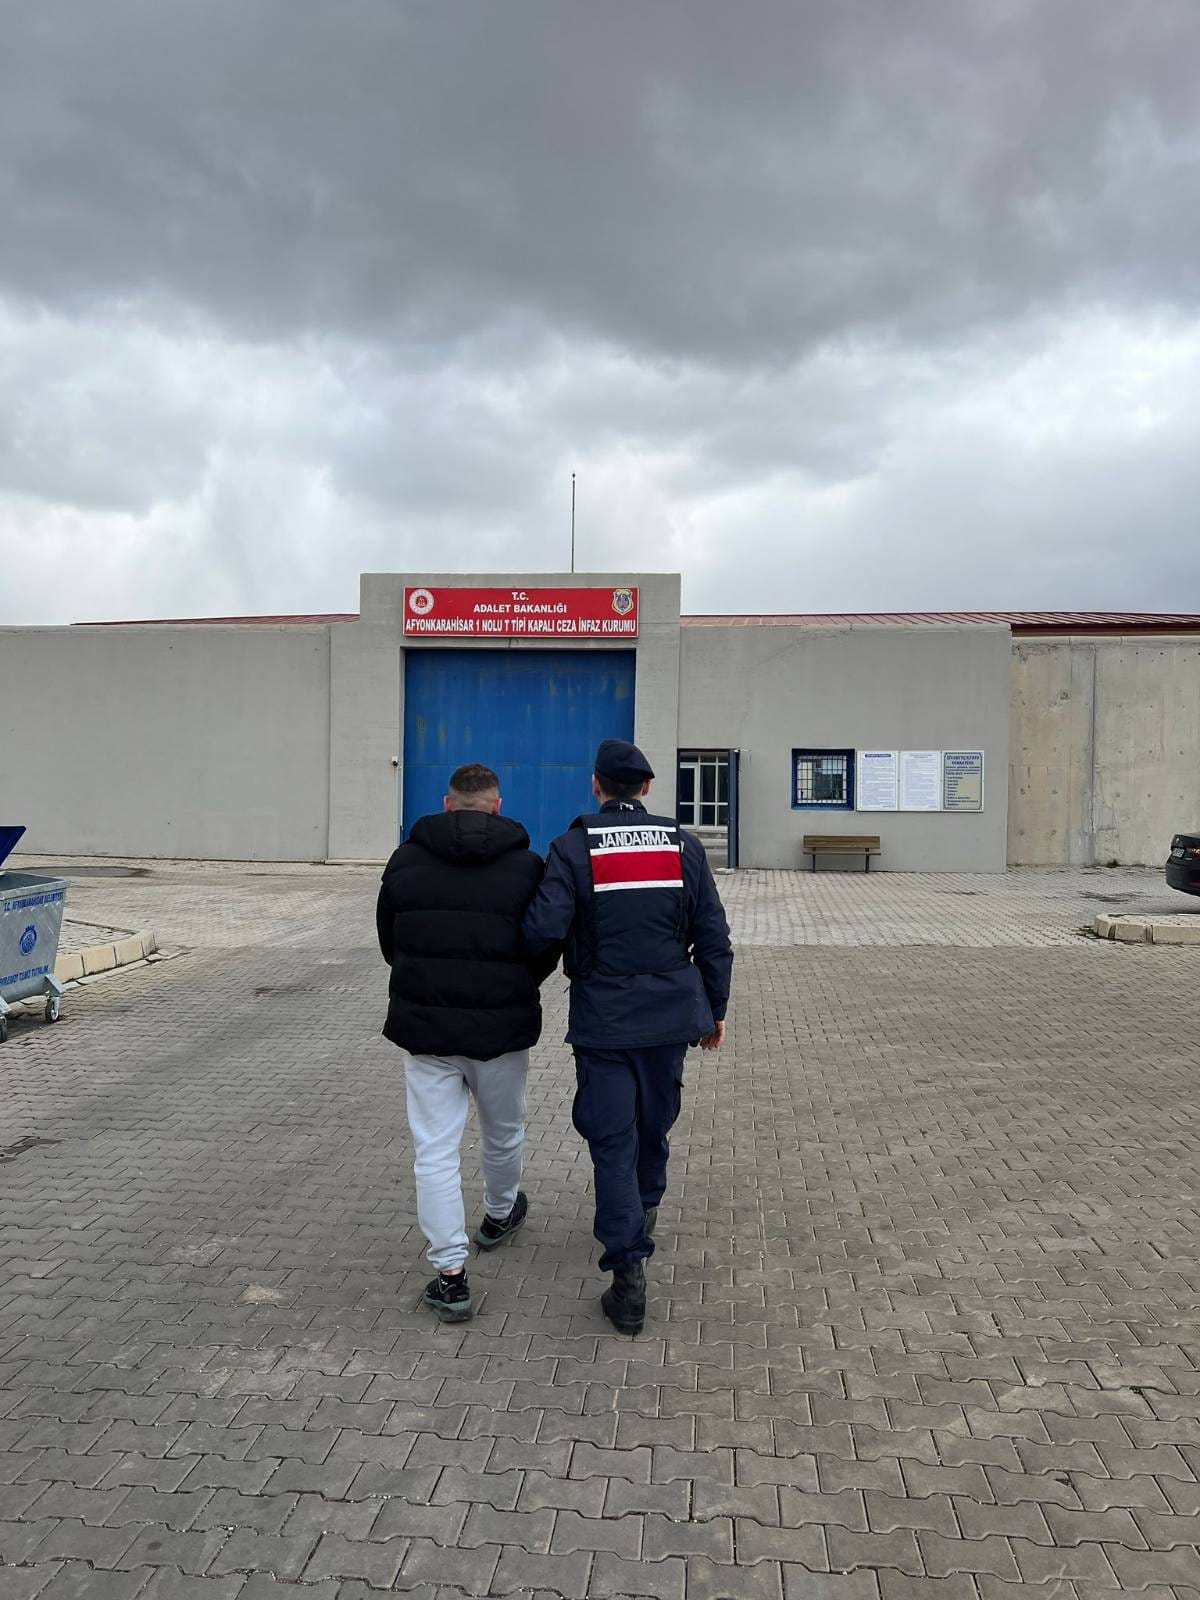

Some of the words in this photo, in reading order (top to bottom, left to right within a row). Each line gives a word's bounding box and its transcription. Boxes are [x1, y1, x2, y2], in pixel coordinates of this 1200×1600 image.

[512, 592, 529, 601] T.C.
[473, 604, 511, 613] ADALET
[514, 602, 567, 613] BAKANLIĞI
[406, 616, 474, 632] AFYONKARAHİSAR
[476, 619, 480, 632] 1
[482, 619, 503, 632] NOLU
[504, 619, 510, 632] T
[511, 616, 526, 632] TİPİ
[528, 619, 555, 632] KAPALI
[556, 619, 577, 632] CEZA
[578, 616, 601, 633] İNFAZ
[602, 619, 636, 633] KURUMU
[598, 831, 671, 848] JANDARMA
